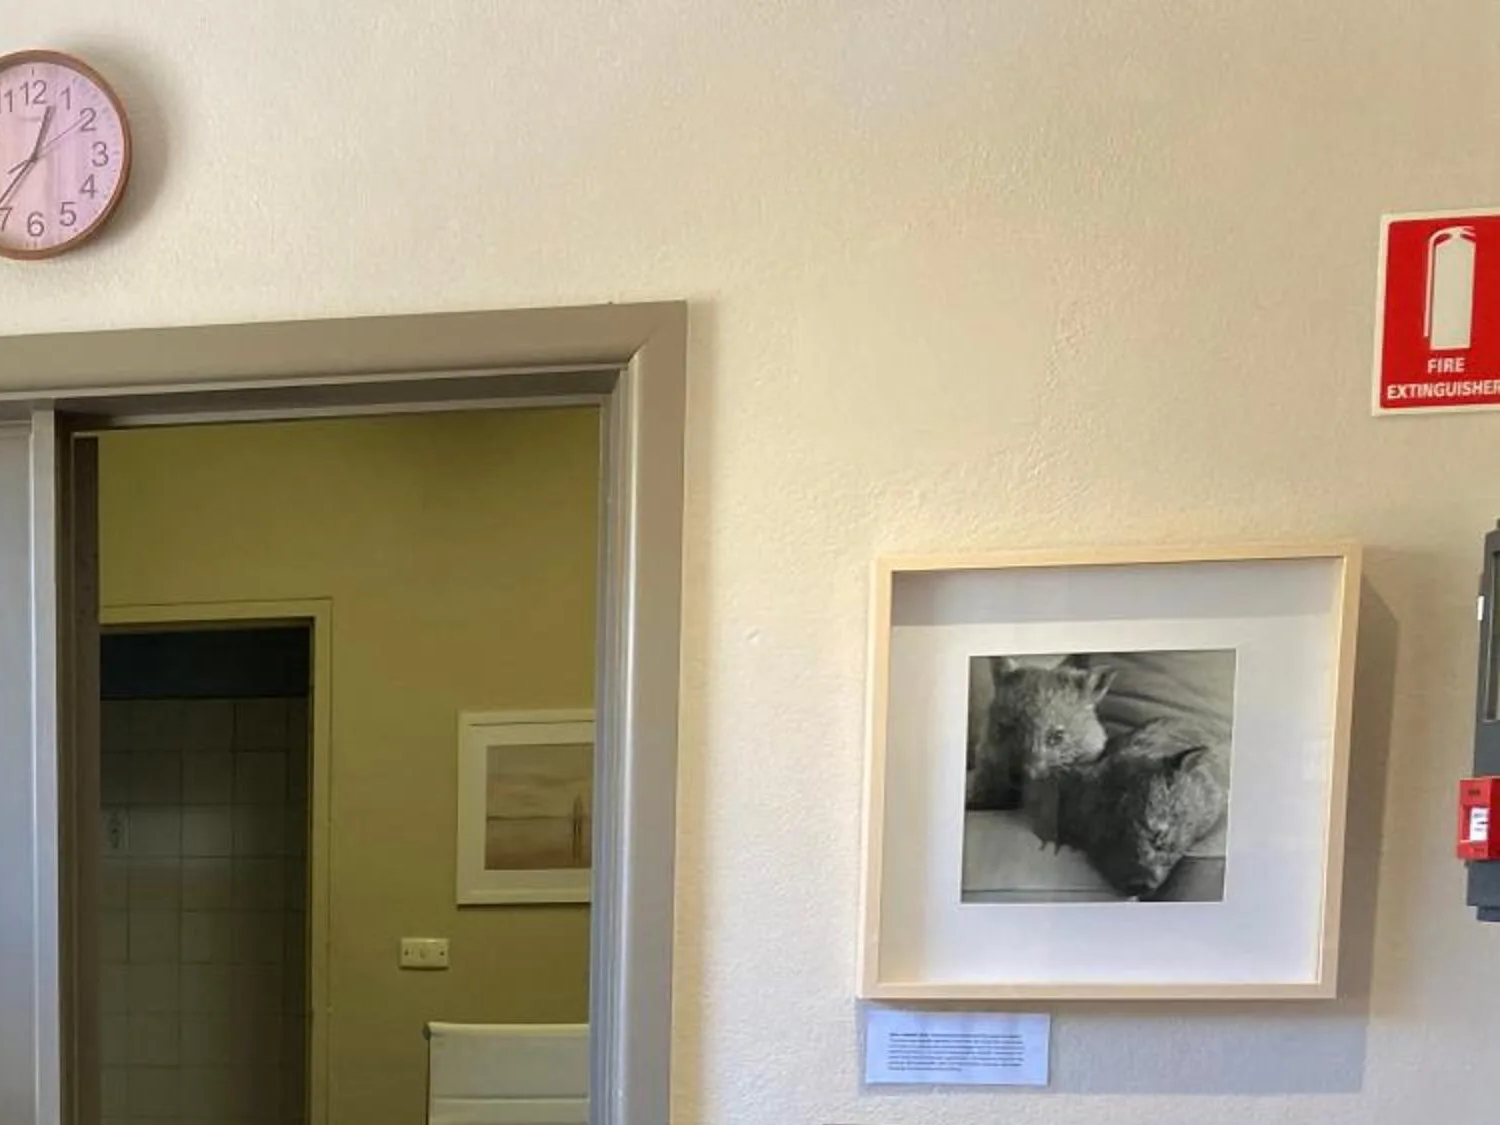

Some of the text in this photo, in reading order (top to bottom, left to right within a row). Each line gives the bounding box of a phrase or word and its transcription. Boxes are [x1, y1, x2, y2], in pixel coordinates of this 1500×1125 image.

[20, 79, 48, 105] 12
[61, 87, 71, 111] 1
[79, 107, 97, 132] 2
[91, 141, 109, 167] 3
[79, 174, 97, 199] 4
[27, 211, 45, 237] 6
[59, 202, 77, 227] 5
[1427, 357, 1465, 374] FIRE
